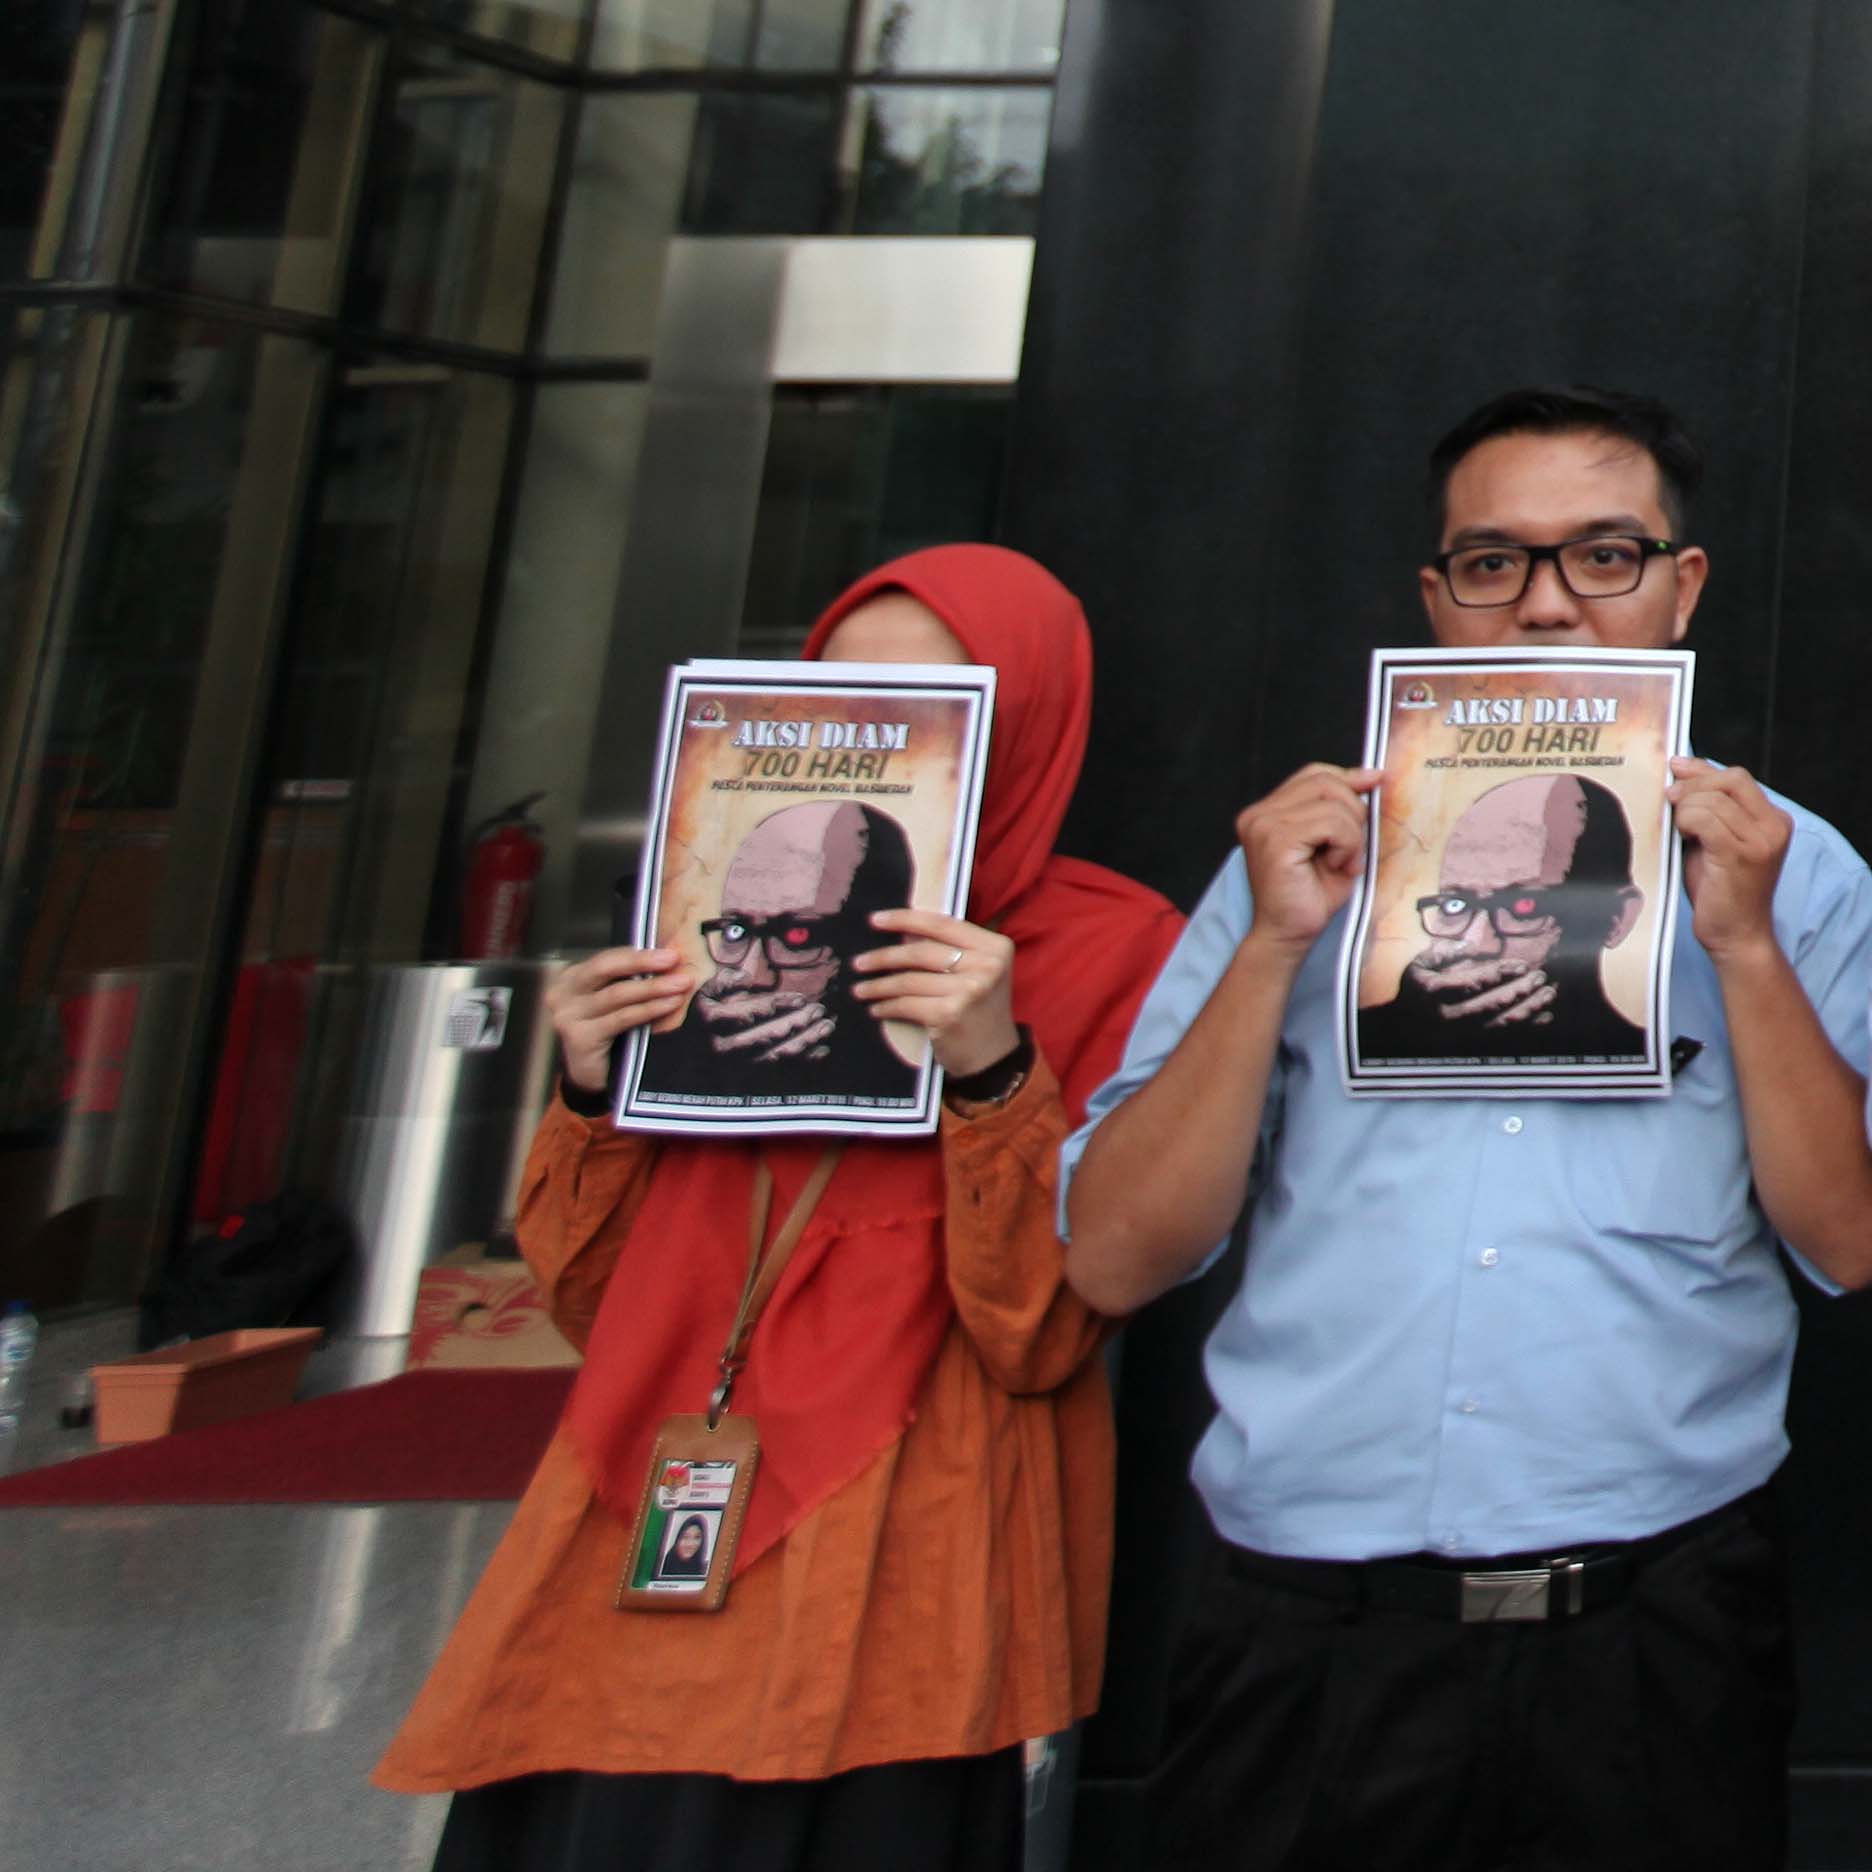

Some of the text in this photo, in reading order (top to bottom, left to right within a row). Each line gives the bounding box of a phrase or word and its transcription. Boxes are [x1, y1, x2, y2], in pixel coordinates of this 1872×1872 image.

[1444, 697, 1618, 726] AKSI DIAM
[732, 719, 911, 750] AKSI DIAM
[1457, 727, 1602, 754] 700 HARI
[744, 750, 891, 779] 700 HARI
